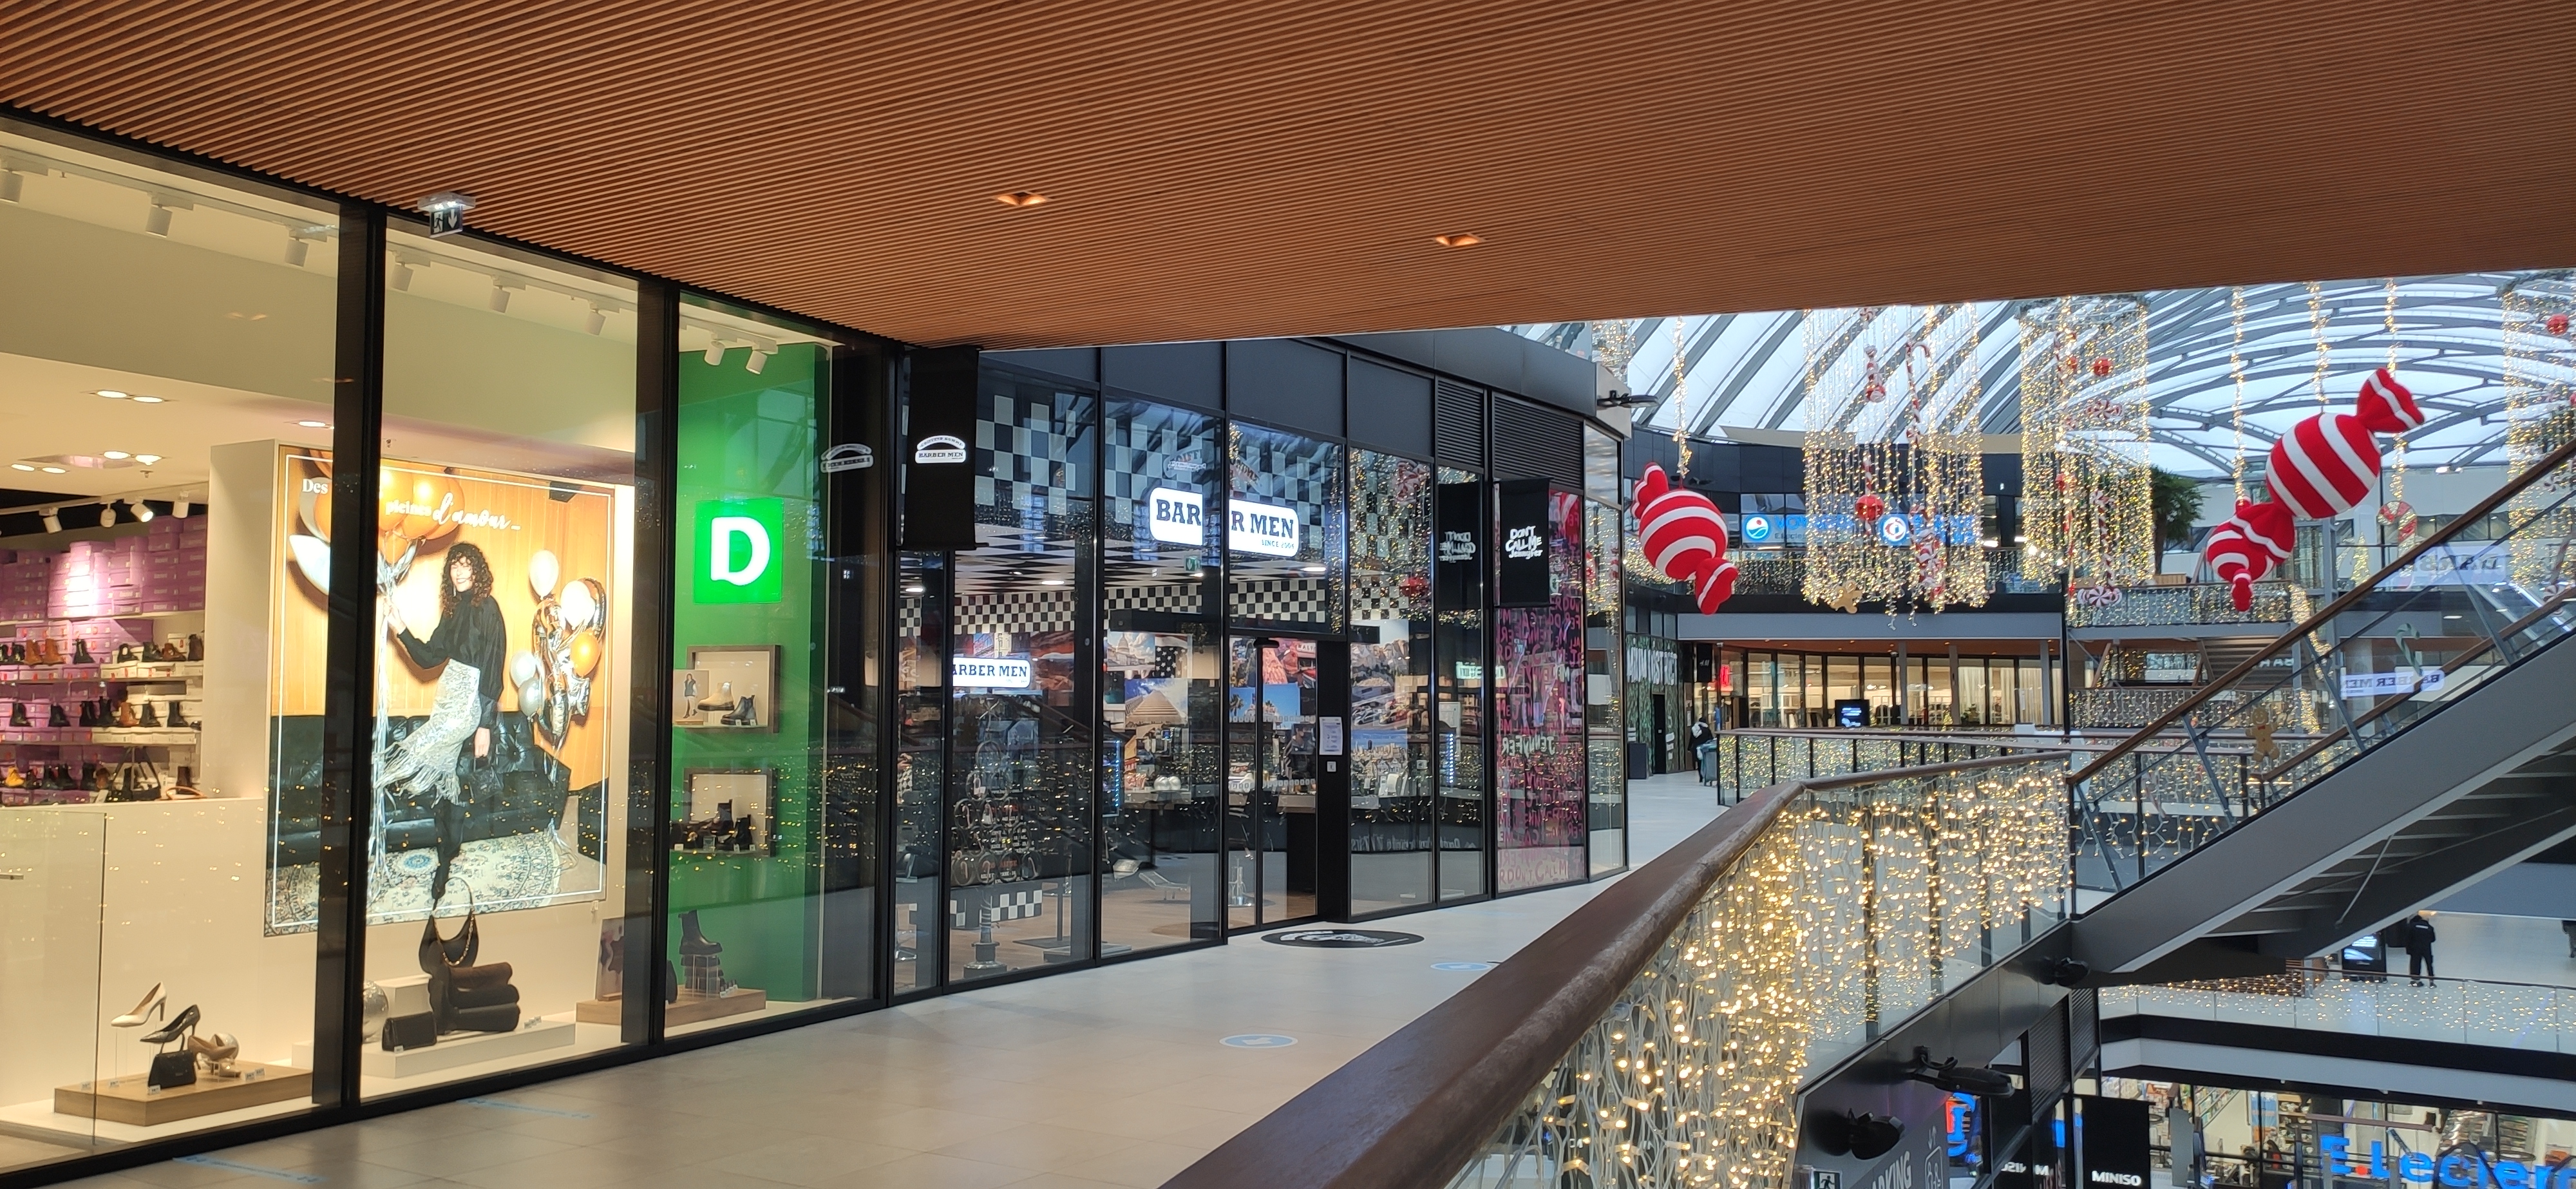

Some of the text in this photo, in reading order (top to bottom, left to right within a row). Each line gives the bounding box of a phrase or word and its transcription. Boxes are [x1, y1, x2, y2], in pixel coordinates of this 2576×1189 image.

[302, 478, 328, 495] Des
[1250, 513, 1294, 539] MEN
[710, 517, 770, 585] D
[952, 664, 1027, 677] ARBER MEN
[2092, 1170, 2142, 1186] MINISO
